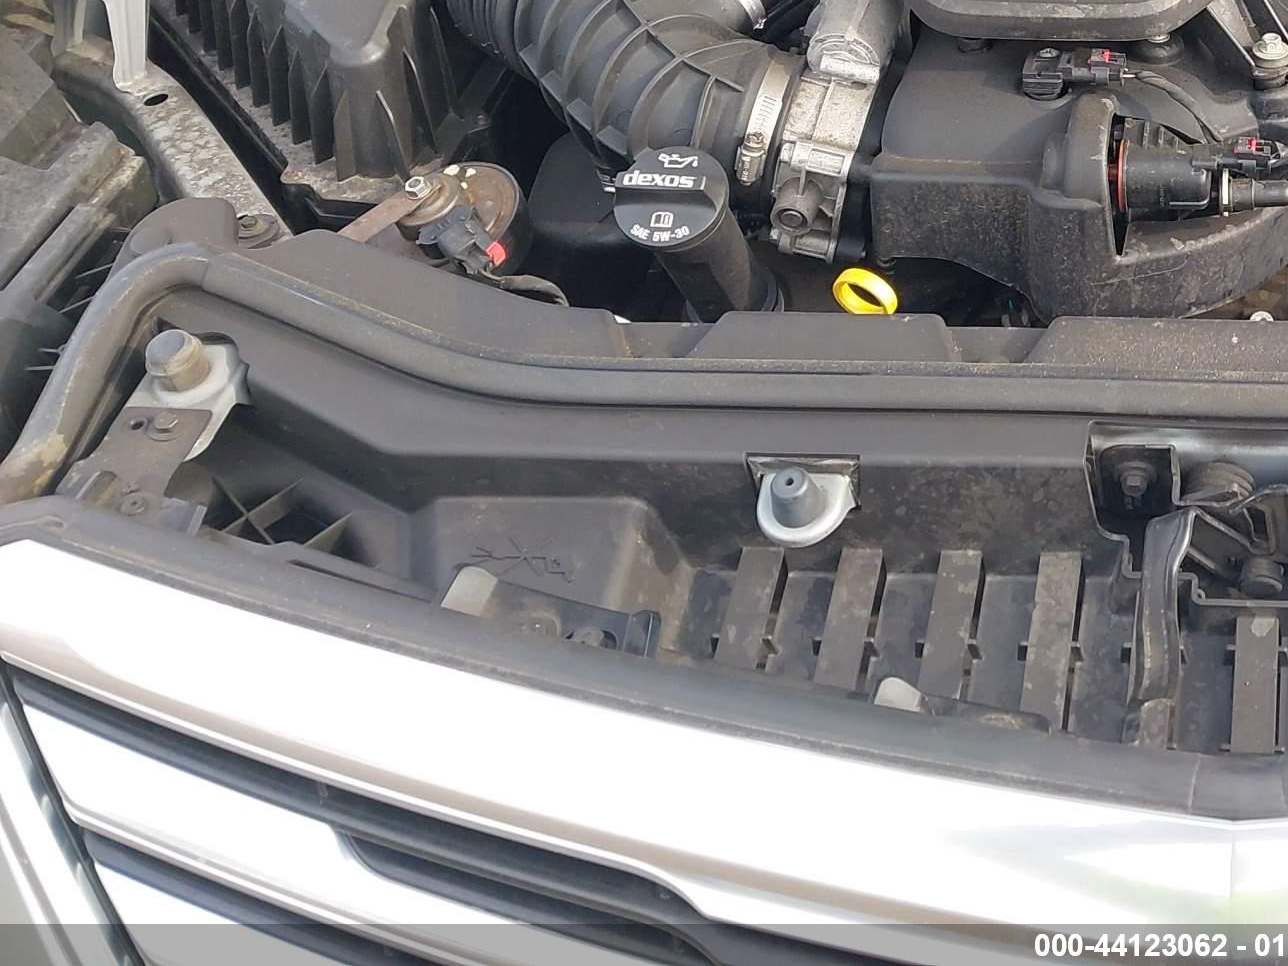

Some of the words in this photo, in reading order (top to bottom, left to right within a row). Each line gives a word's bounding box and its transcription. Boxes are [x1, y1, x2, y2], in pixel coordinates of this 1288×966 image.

[623, 170, 698, 188] dexos
[631, 224, 650, 240] SAE
[652, 225, 690, 242] 5W-30
